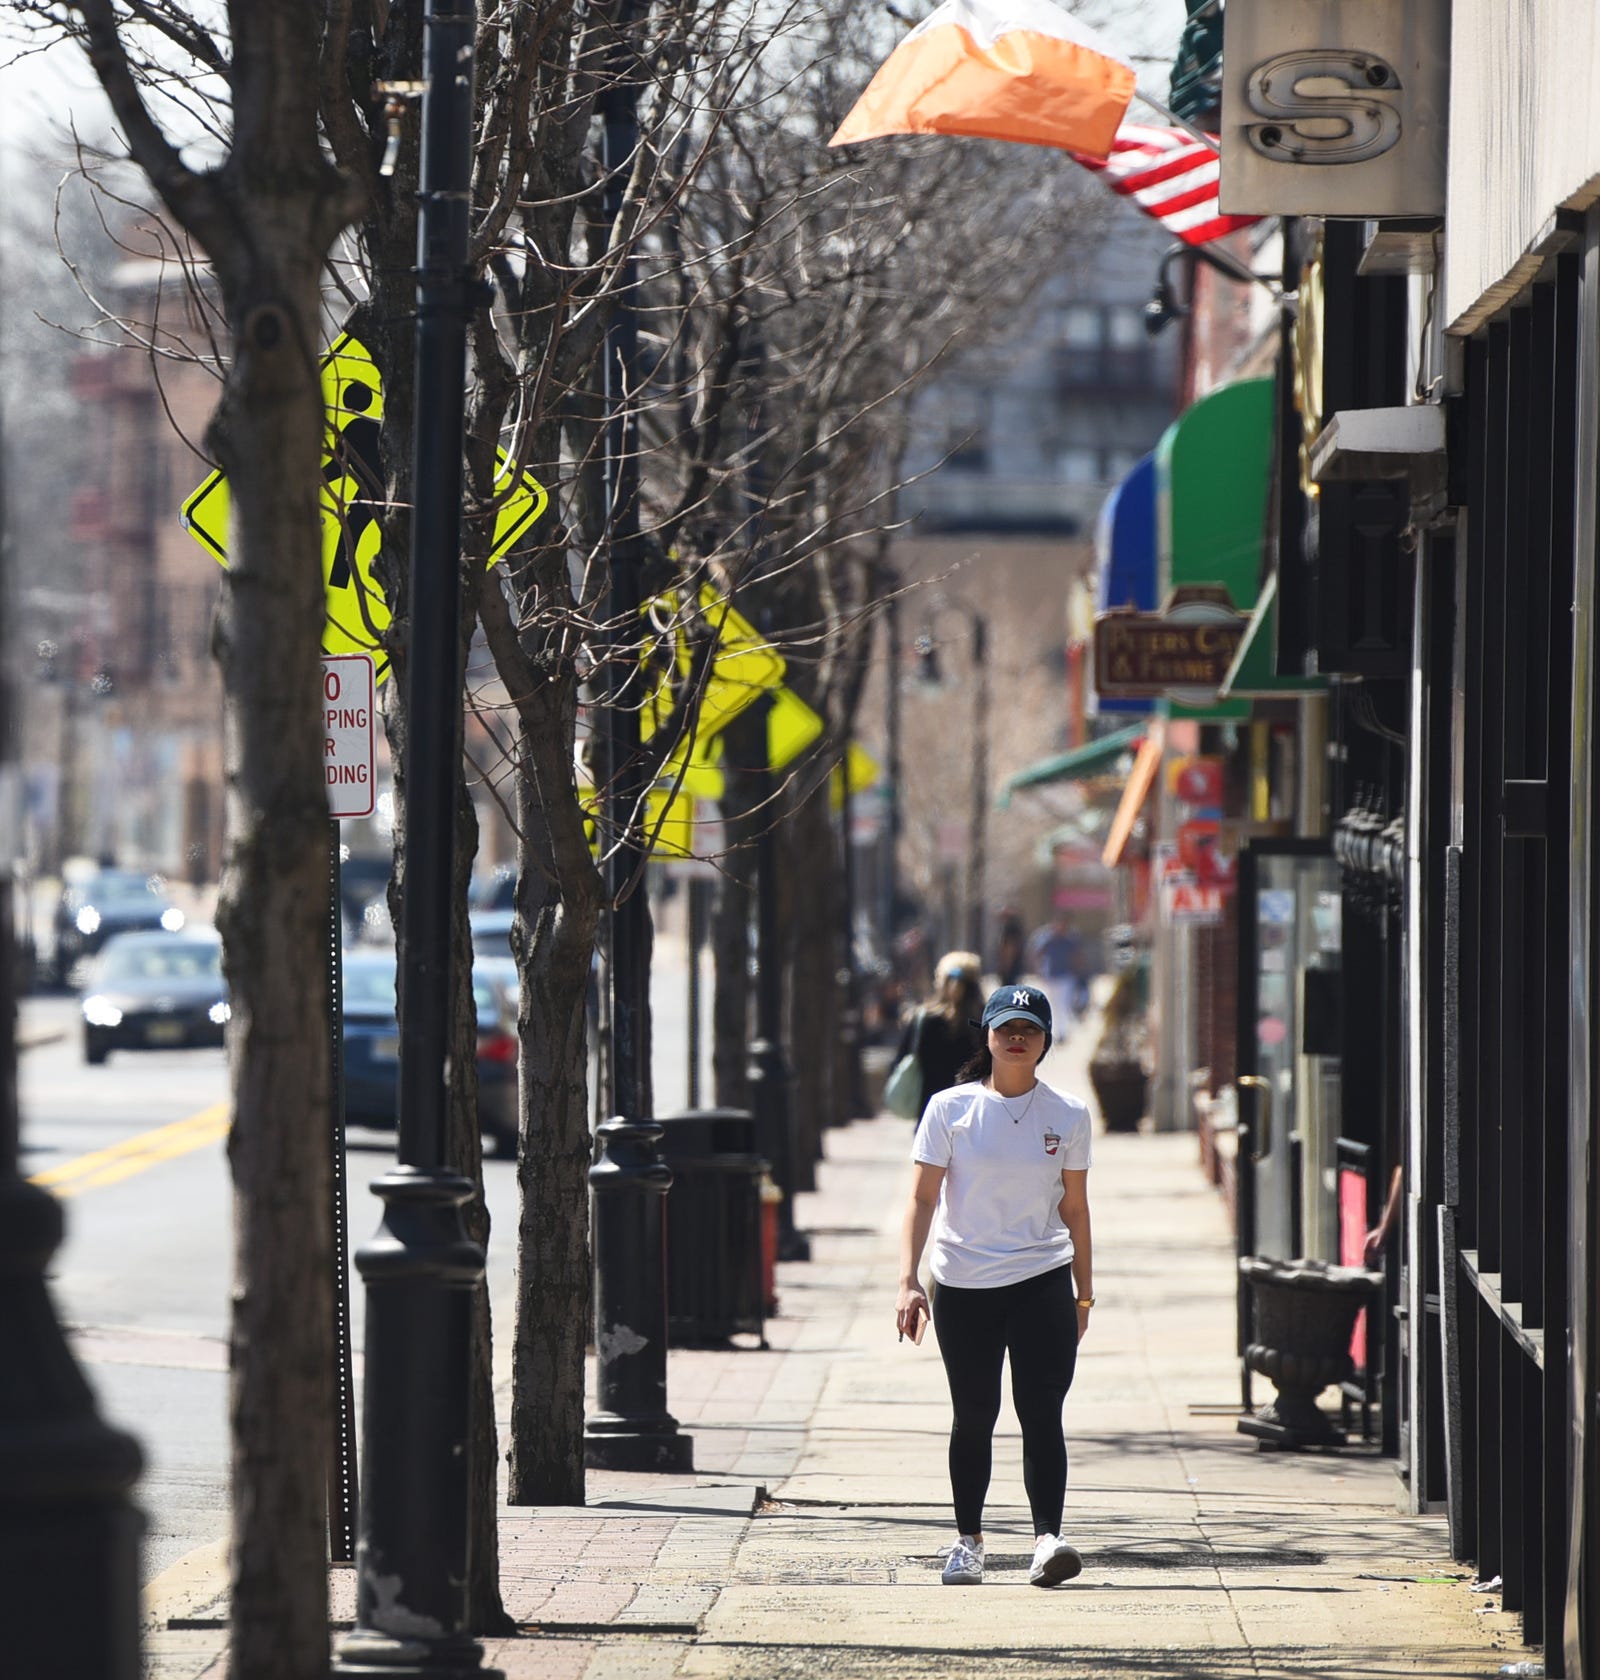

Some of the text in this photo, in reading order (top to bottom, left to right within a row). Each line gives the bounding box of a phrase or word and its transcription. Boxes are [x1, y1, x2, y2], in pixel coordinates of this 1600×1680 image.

[1243, 49, 1402, 165] S
[324, 672, 341, 701] O
[321, 708, 367, 729] PING
[324, 738, 336, 757] R
[324, 763, 368, 785] DING
[1012, 990, 1030, 1006] NY
